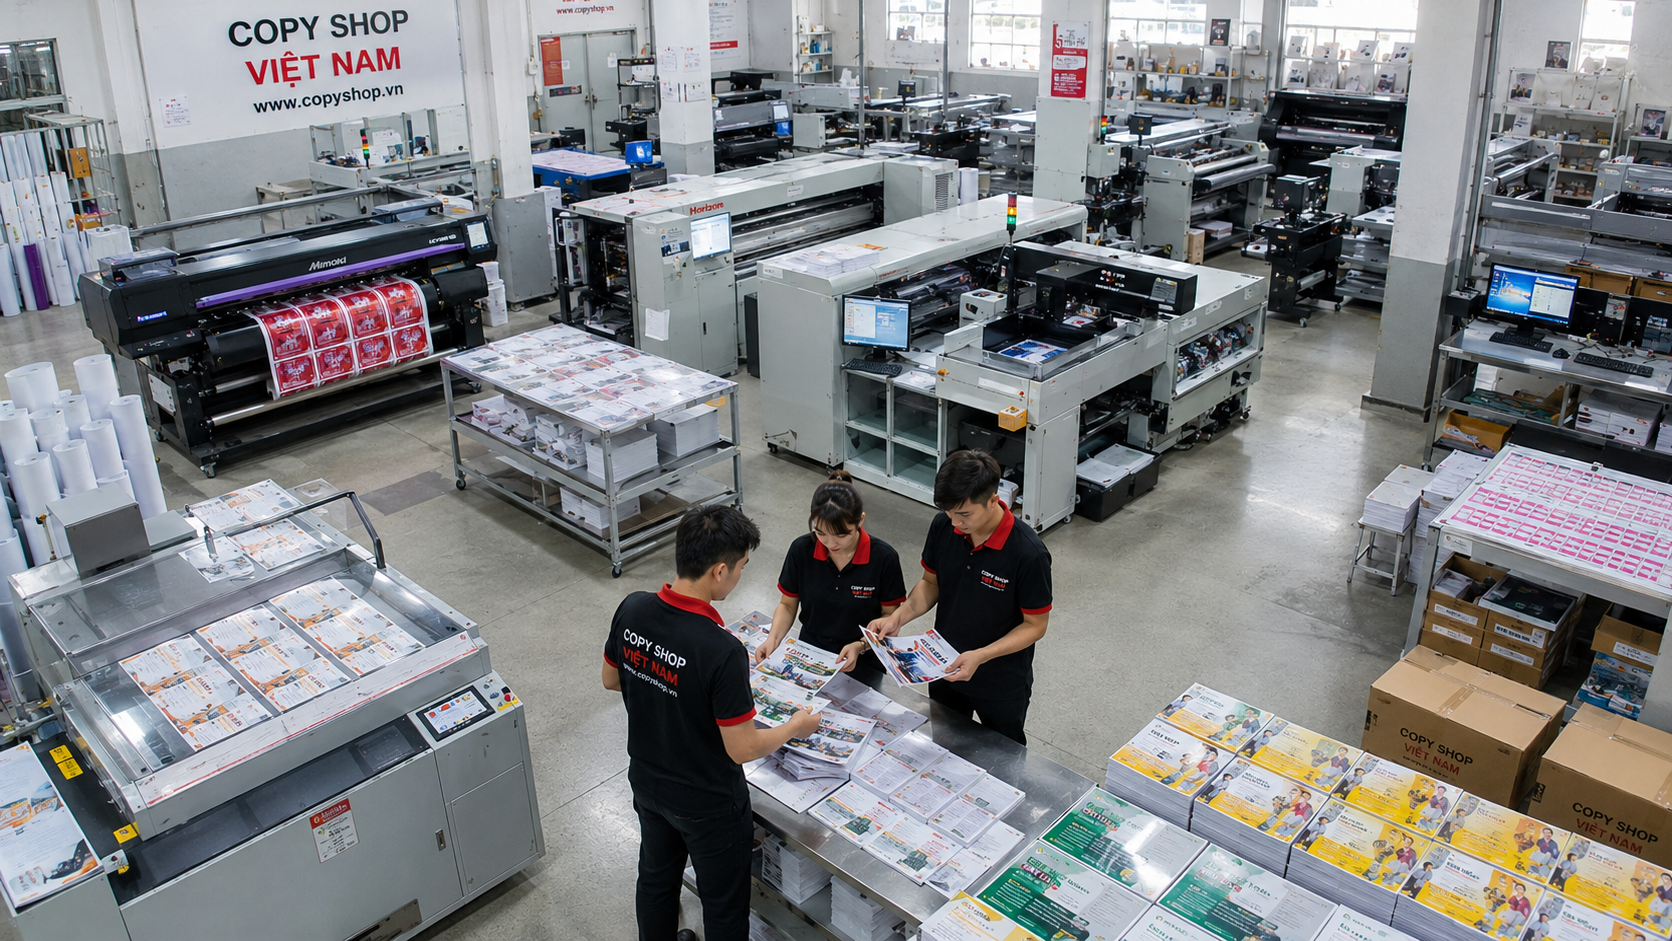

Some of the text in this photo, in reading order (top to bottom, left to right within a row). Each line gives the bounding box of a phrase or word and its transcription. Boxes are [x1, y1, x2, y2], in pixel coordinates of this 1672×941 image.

[228, 9, 409, 47] COPY SHOP
[245, 46, 401, 88] VIỆT NAM
[253, 84, 404, 113] www.copyshop.vn
[622, 645, 678, 686] VIỆT NAM
[623, 628, 687, 669] COPY SHOP
[1400, 727, 1474, 765] COPY SHOP
[1432, 756, 1460, 776] NAM
[1572, 802, 1659, 843] COPY SHOP
[1608, 833, 1643, 855] NAM
